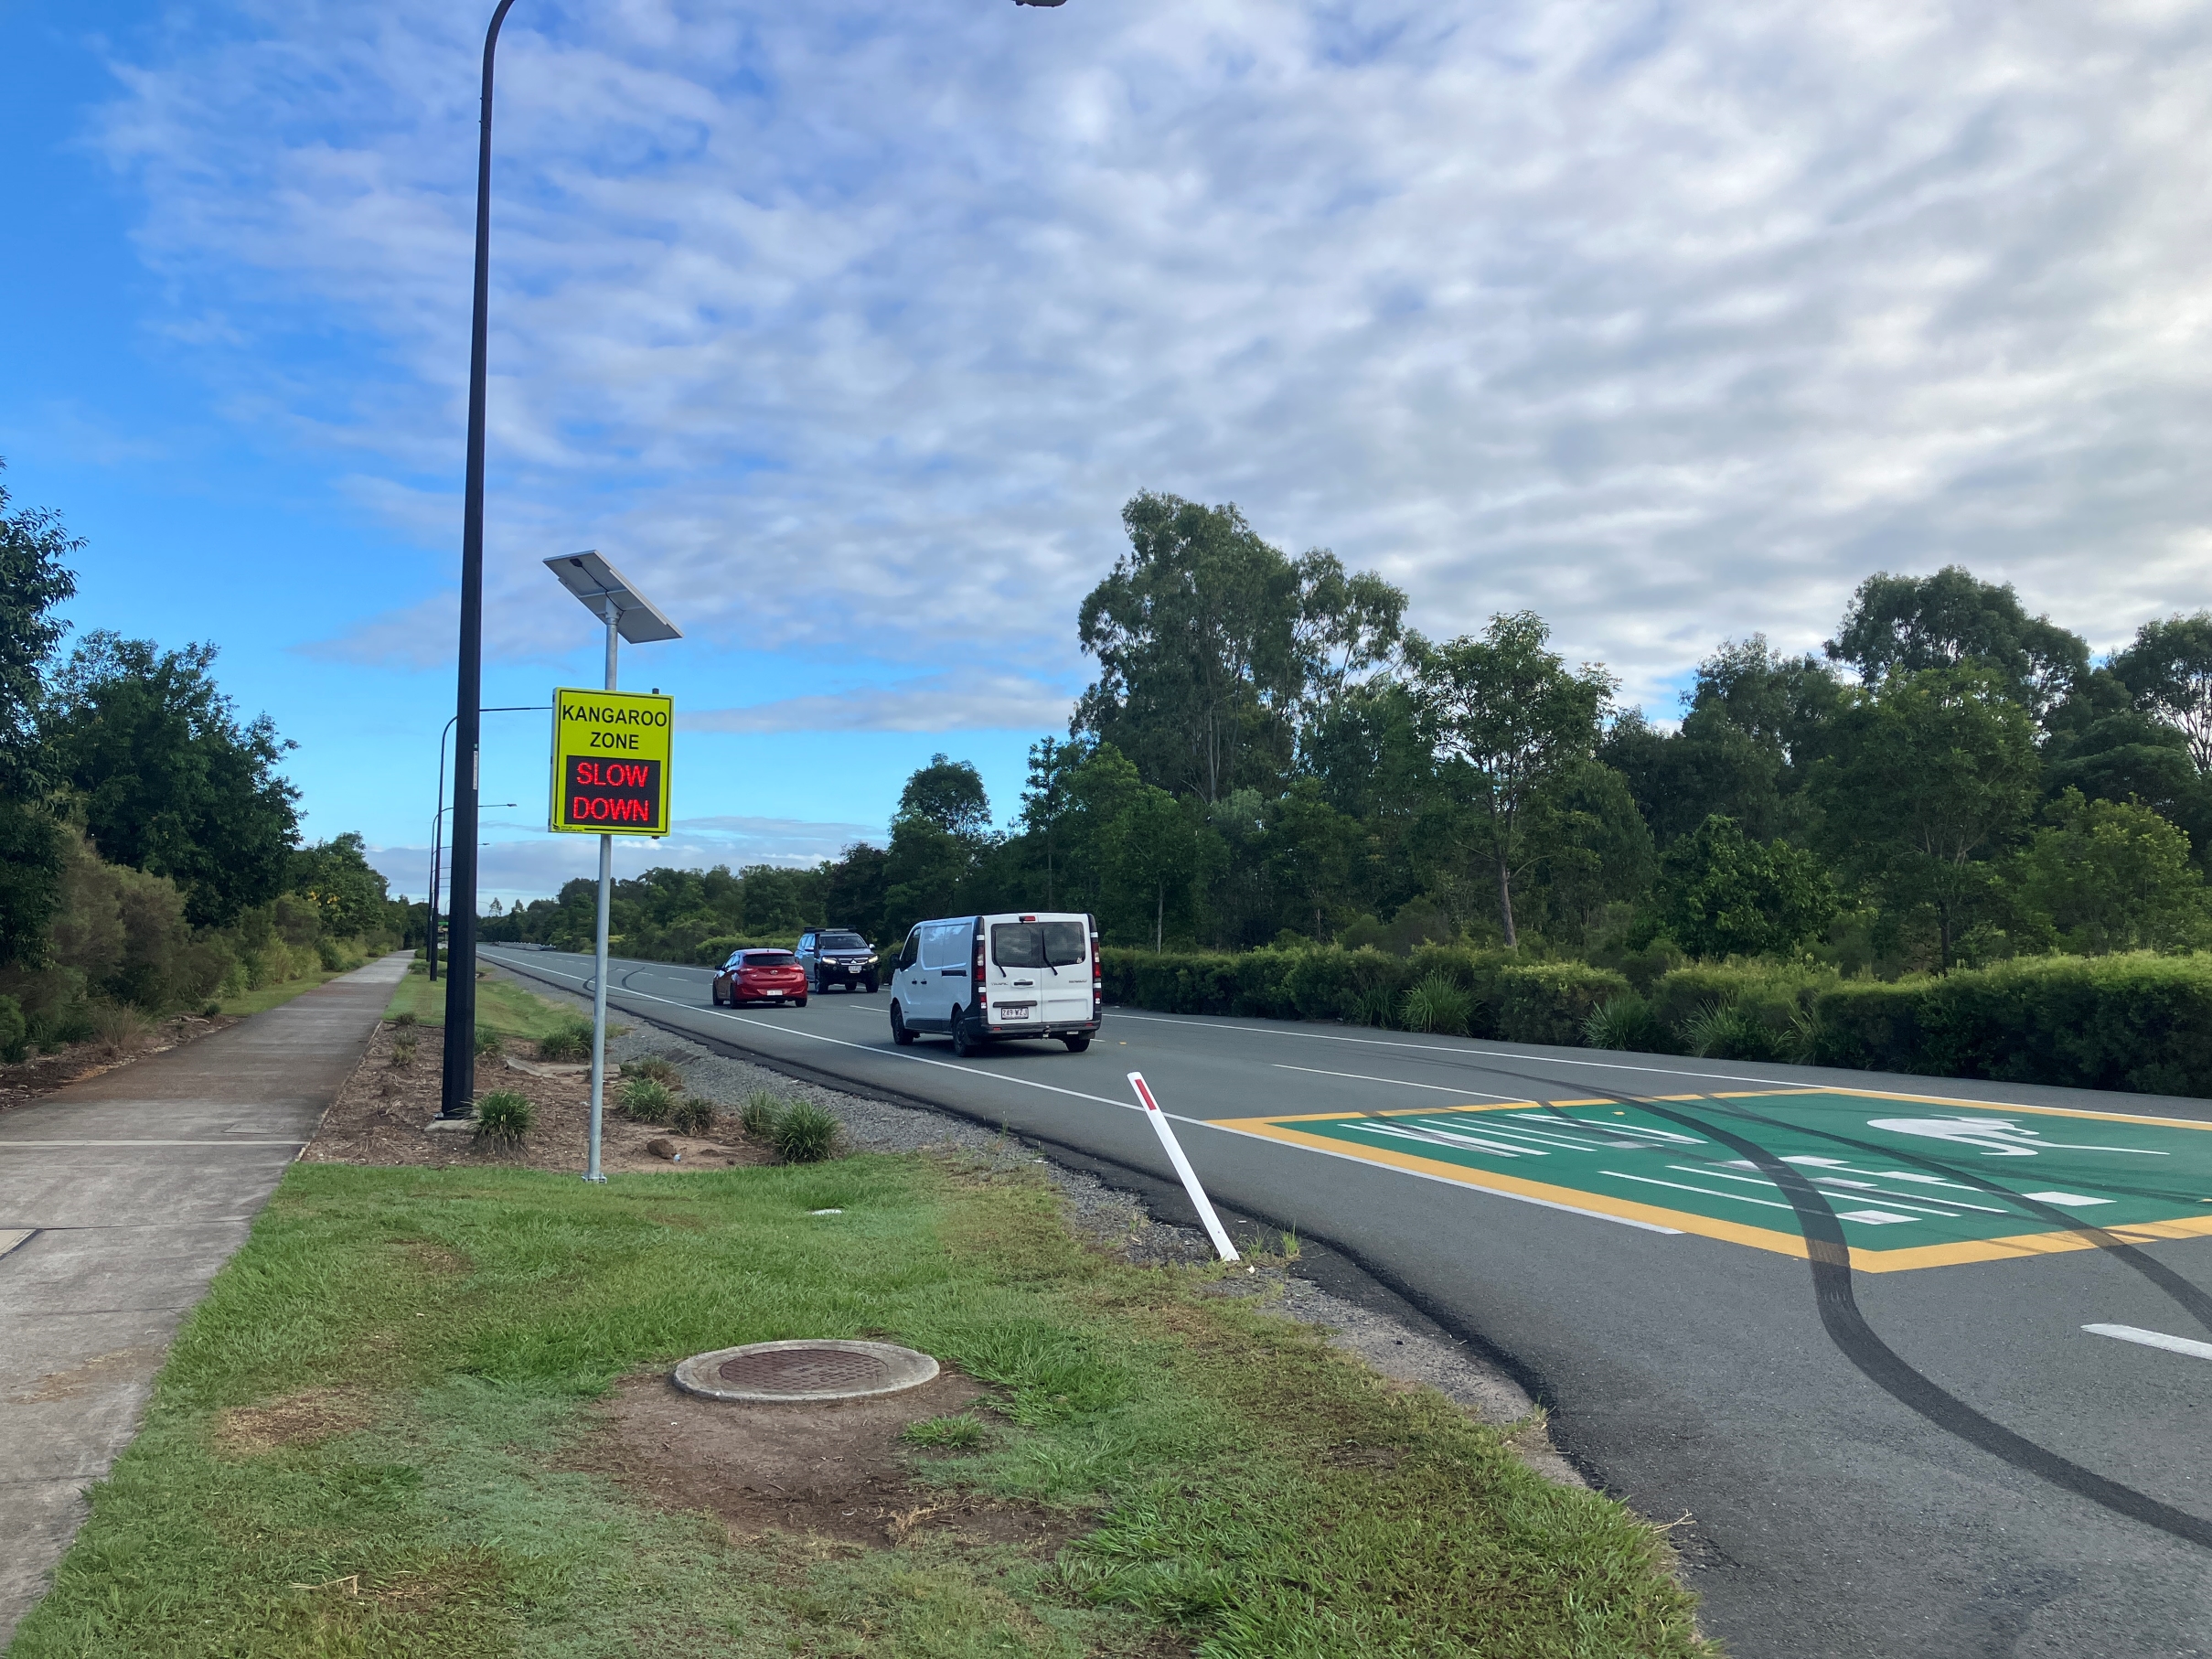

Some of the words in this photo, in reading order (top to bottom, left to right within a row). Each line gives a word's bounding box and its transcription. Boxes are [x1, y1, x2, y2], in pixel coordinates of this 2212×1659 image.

[562, 705, 668, 727] KANGAROO
[590, 732, 639, 750] ZONE
[576, 762, 649, 787] SLOW
[572, 797, 650, 821] DOWN
